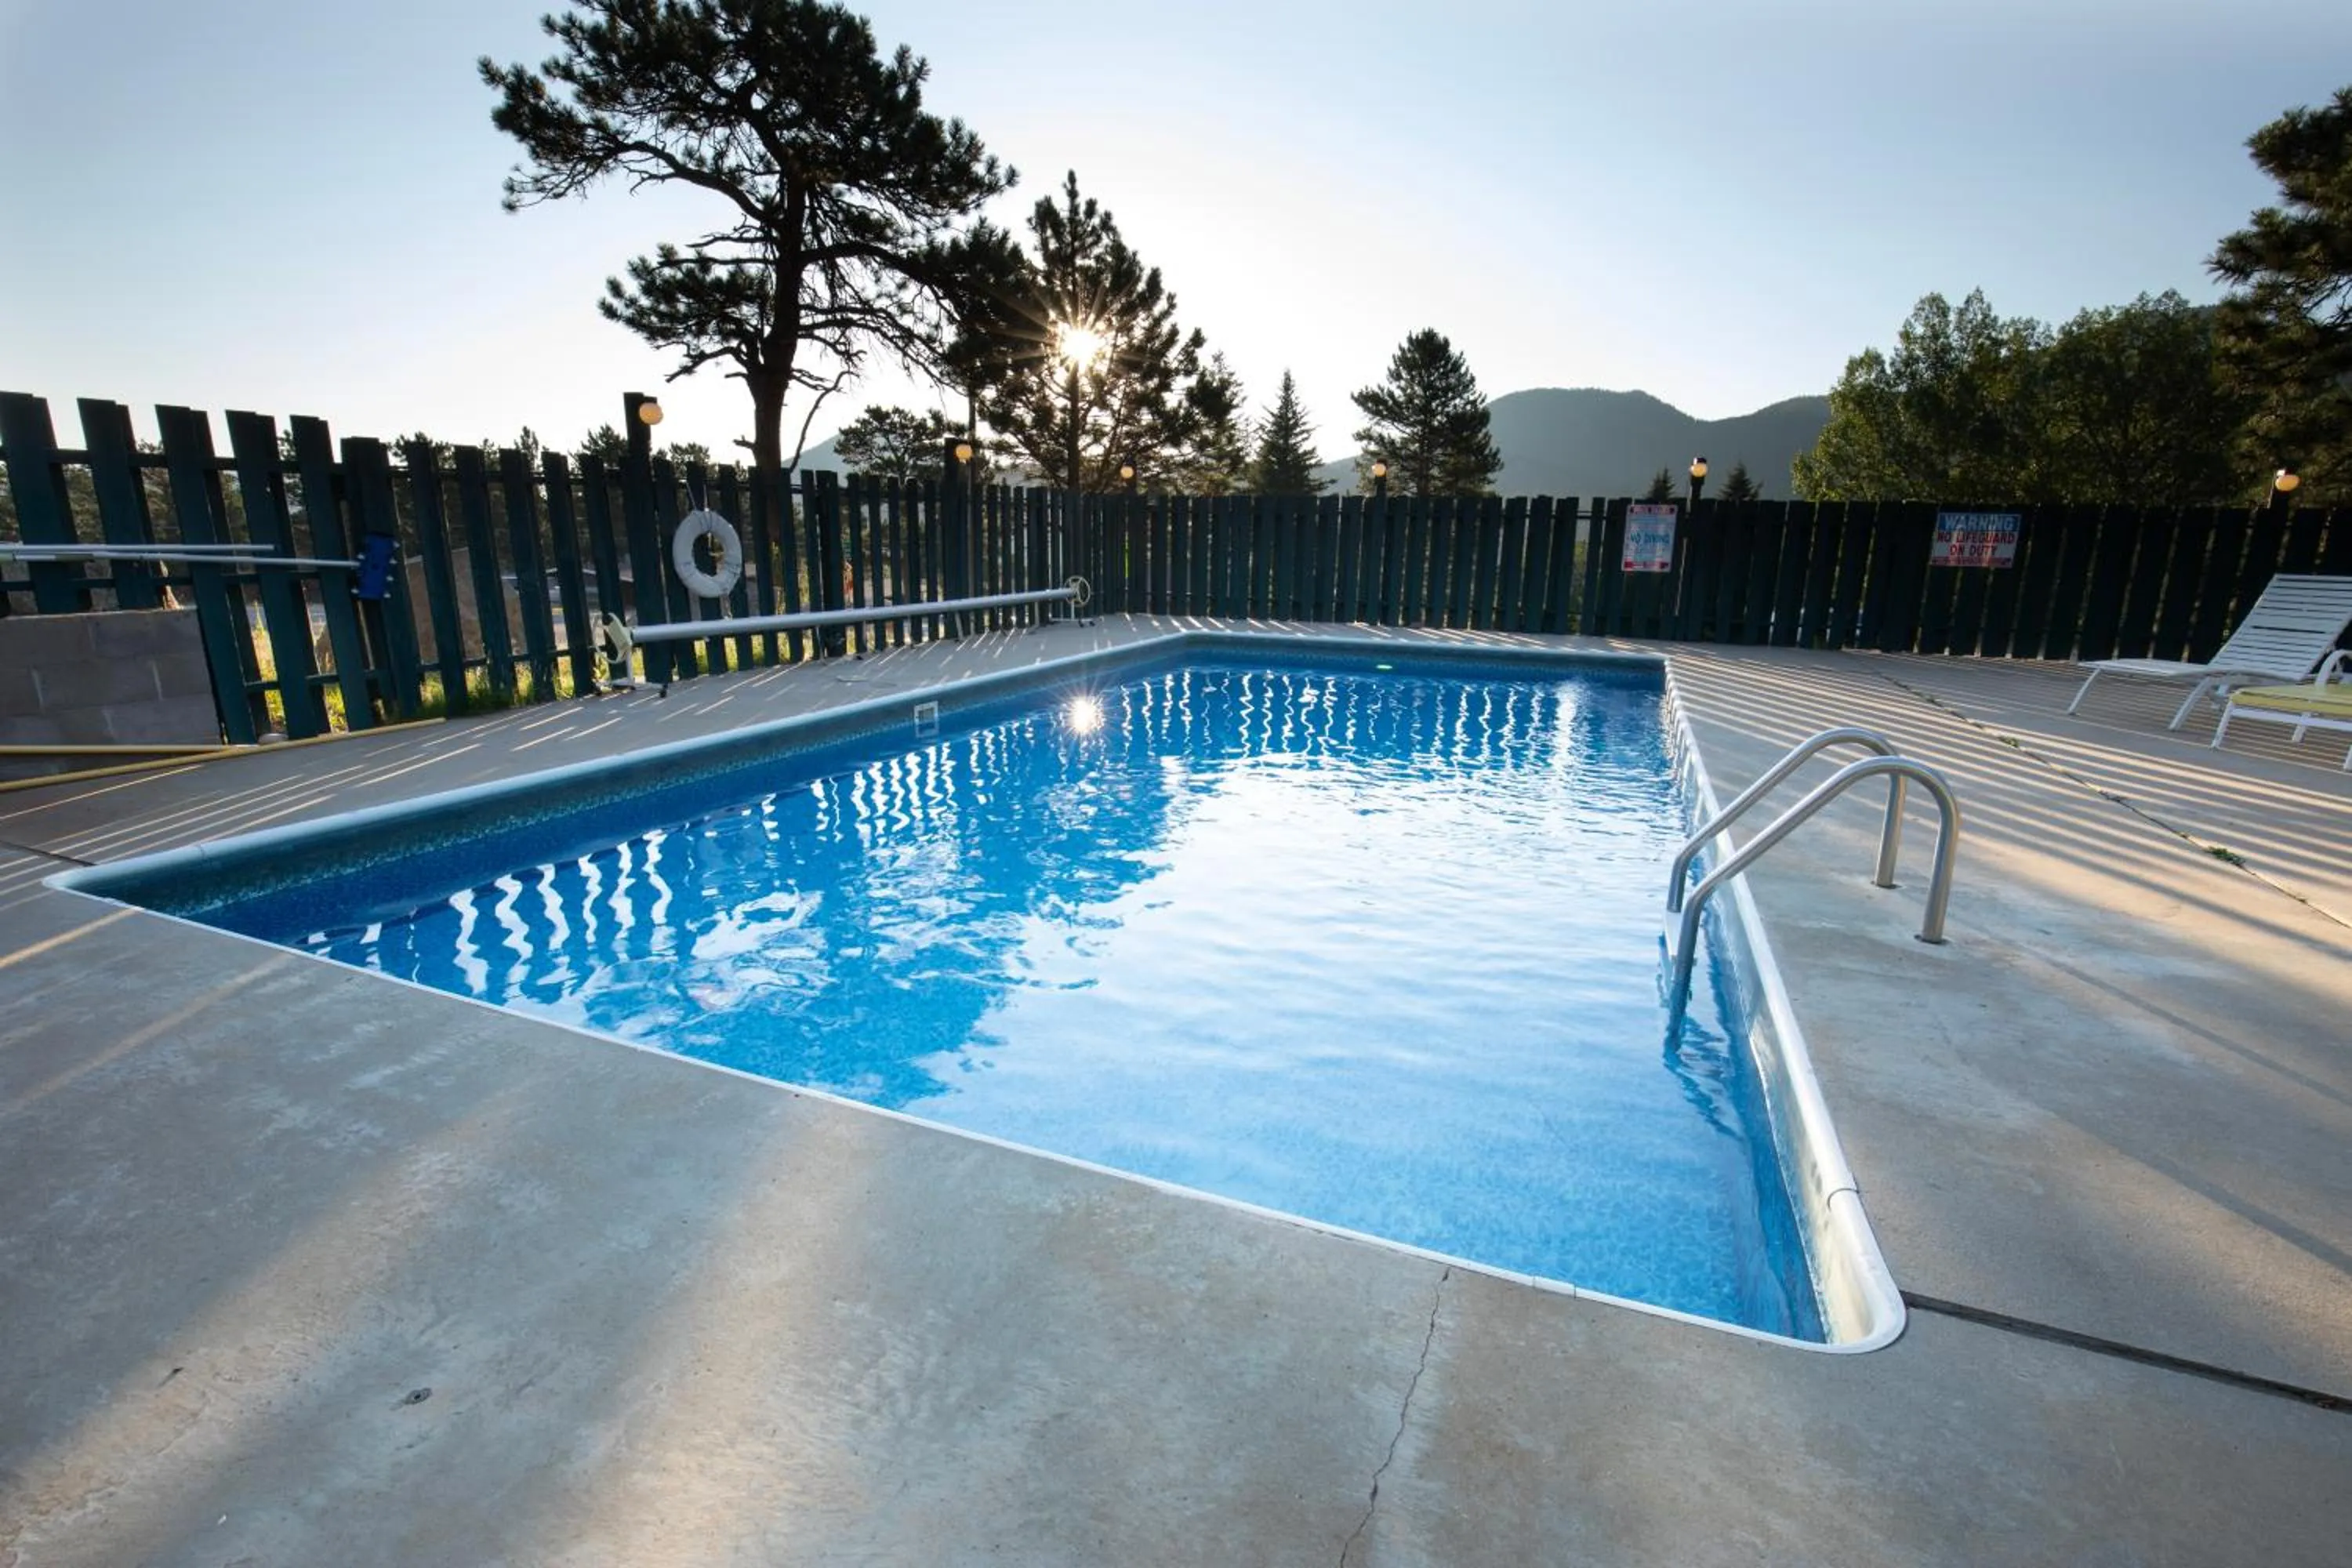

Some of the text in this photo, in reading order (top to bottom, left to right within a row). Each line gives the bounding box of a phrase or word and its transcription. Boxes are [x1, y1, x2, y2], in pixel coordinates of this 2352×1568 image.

[1944, 514, 2015, 531] WARNING
[1938, 532, 2015, 544] NO LIFEGUARD
[1950, 544, 1998, 556] ON DUTY
